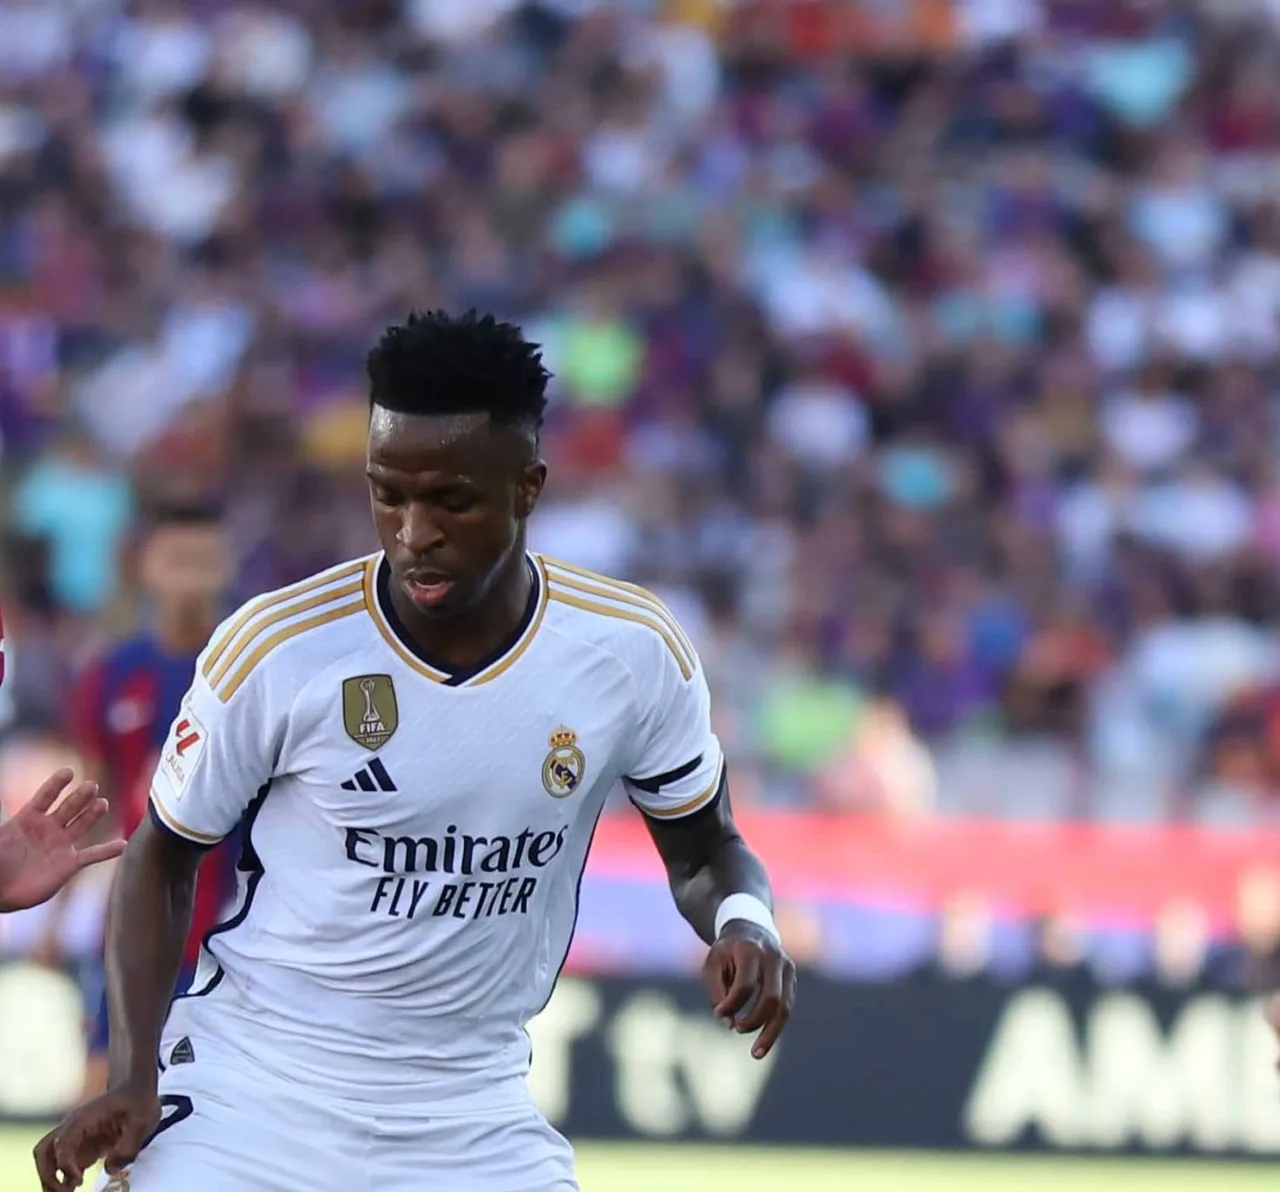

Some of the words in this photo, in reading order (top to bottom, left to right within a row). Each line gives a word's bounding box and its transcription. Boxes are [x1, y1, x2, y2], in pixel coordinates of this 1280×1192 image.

[360, 722, 385, 733] FIFA
[345, 824, 569, 876] Emirates
[370, 876, 429, 920] FLY
[432, 877, 538, 920] BETTER
[608, 988, 782, 1136] tv
